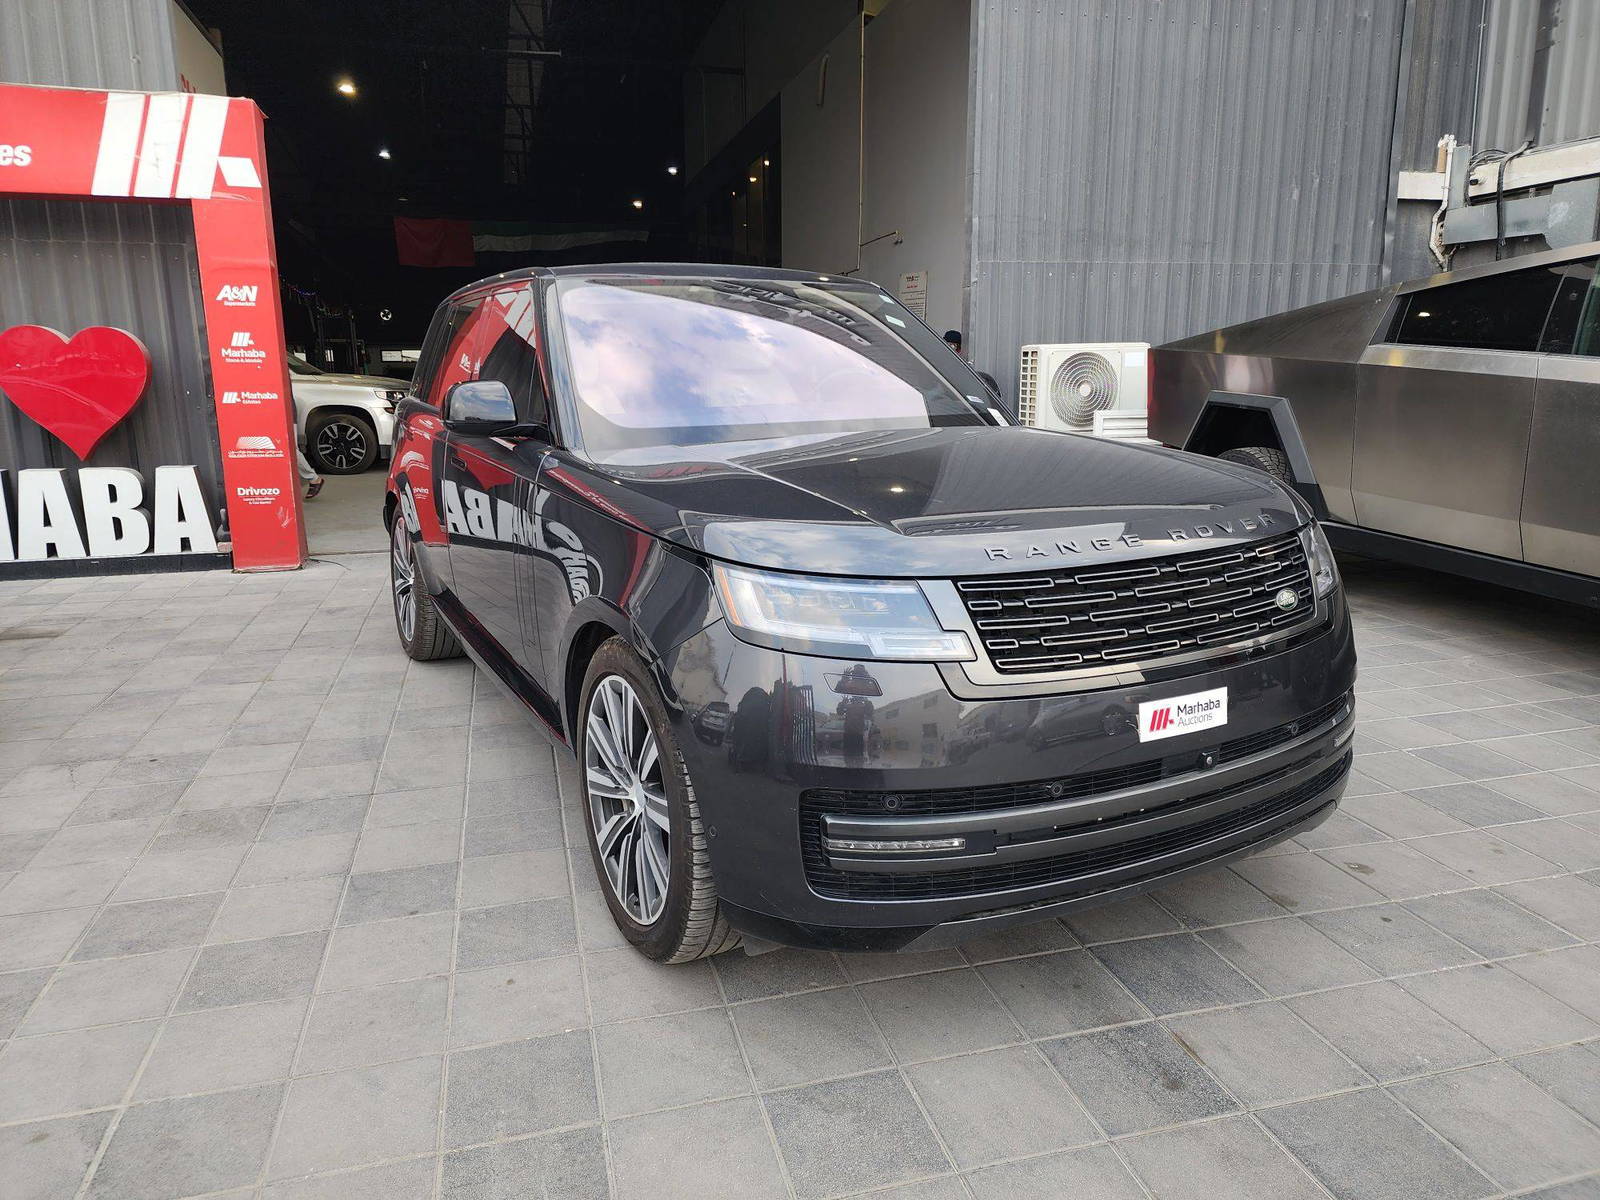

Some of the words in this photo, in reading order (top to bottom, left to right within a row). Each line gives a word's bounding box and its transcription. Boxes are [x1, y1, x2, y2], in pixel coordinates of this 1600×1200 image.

[216, 285, 258, 301] A&N
[221, 348, 267, 358] Marhaba
[241, 391, 279, 400] Marhaba
[237, 486, 281, 497] Drivozo
[984, 533, 1143, 561] RANGE
[1166, 512, 1276, 541] ROVER
[1176, 698, 1222, 719] Marhaba
[1177, 712, 1214, 727] Auctions
